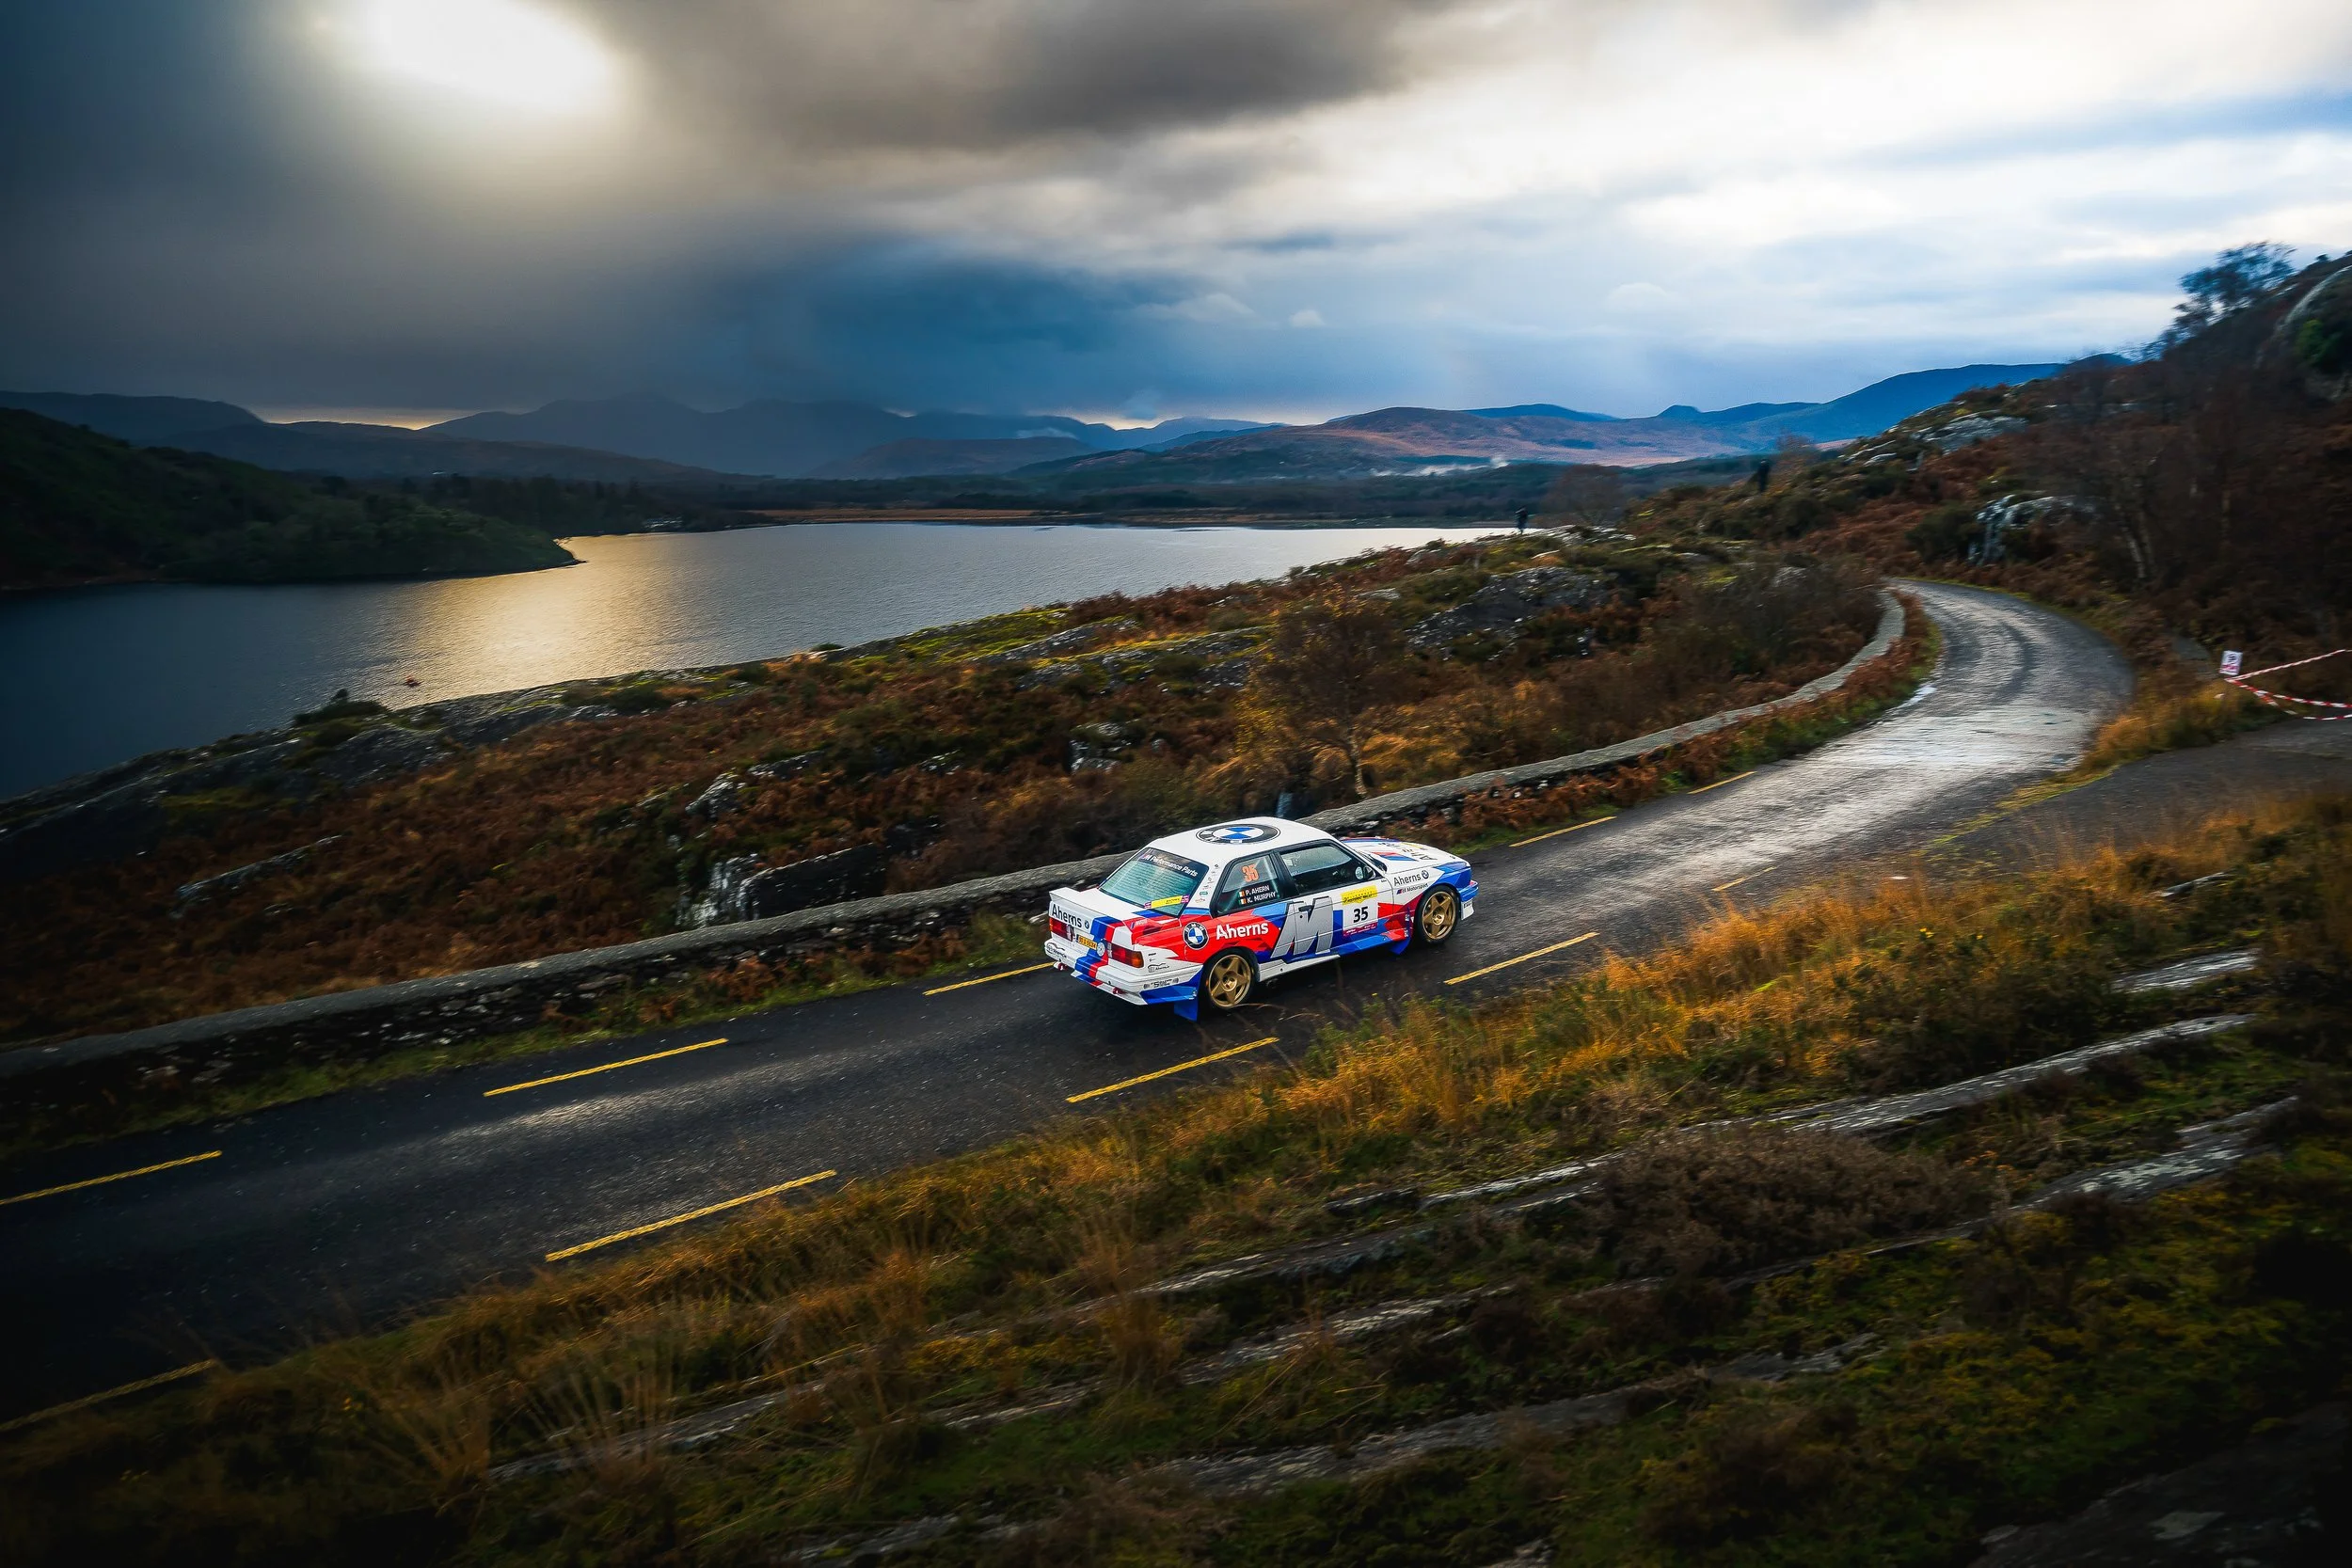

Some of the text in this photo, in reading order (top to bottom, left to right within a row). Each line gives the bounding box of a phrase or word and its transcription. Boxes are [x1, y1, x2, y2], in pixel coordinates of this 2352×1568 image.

[1150, 855, 1183, 871] Performance
[1181, 865, 1199, 877] Parts
[1241, 863, 1260, 882] 35
[1393, 873, 1422, 886] Aherns
[1406, 882, 1429, 893] Motorsport
[1251, 884, 1270, 895] AHERN
[1253, 891, 1276, 902] MURPHY
[1052, 903, 1082, 929] Aherns
[1353, 906, 1369, 923] 35
[1216, 922, 1269, 940] Aherns
